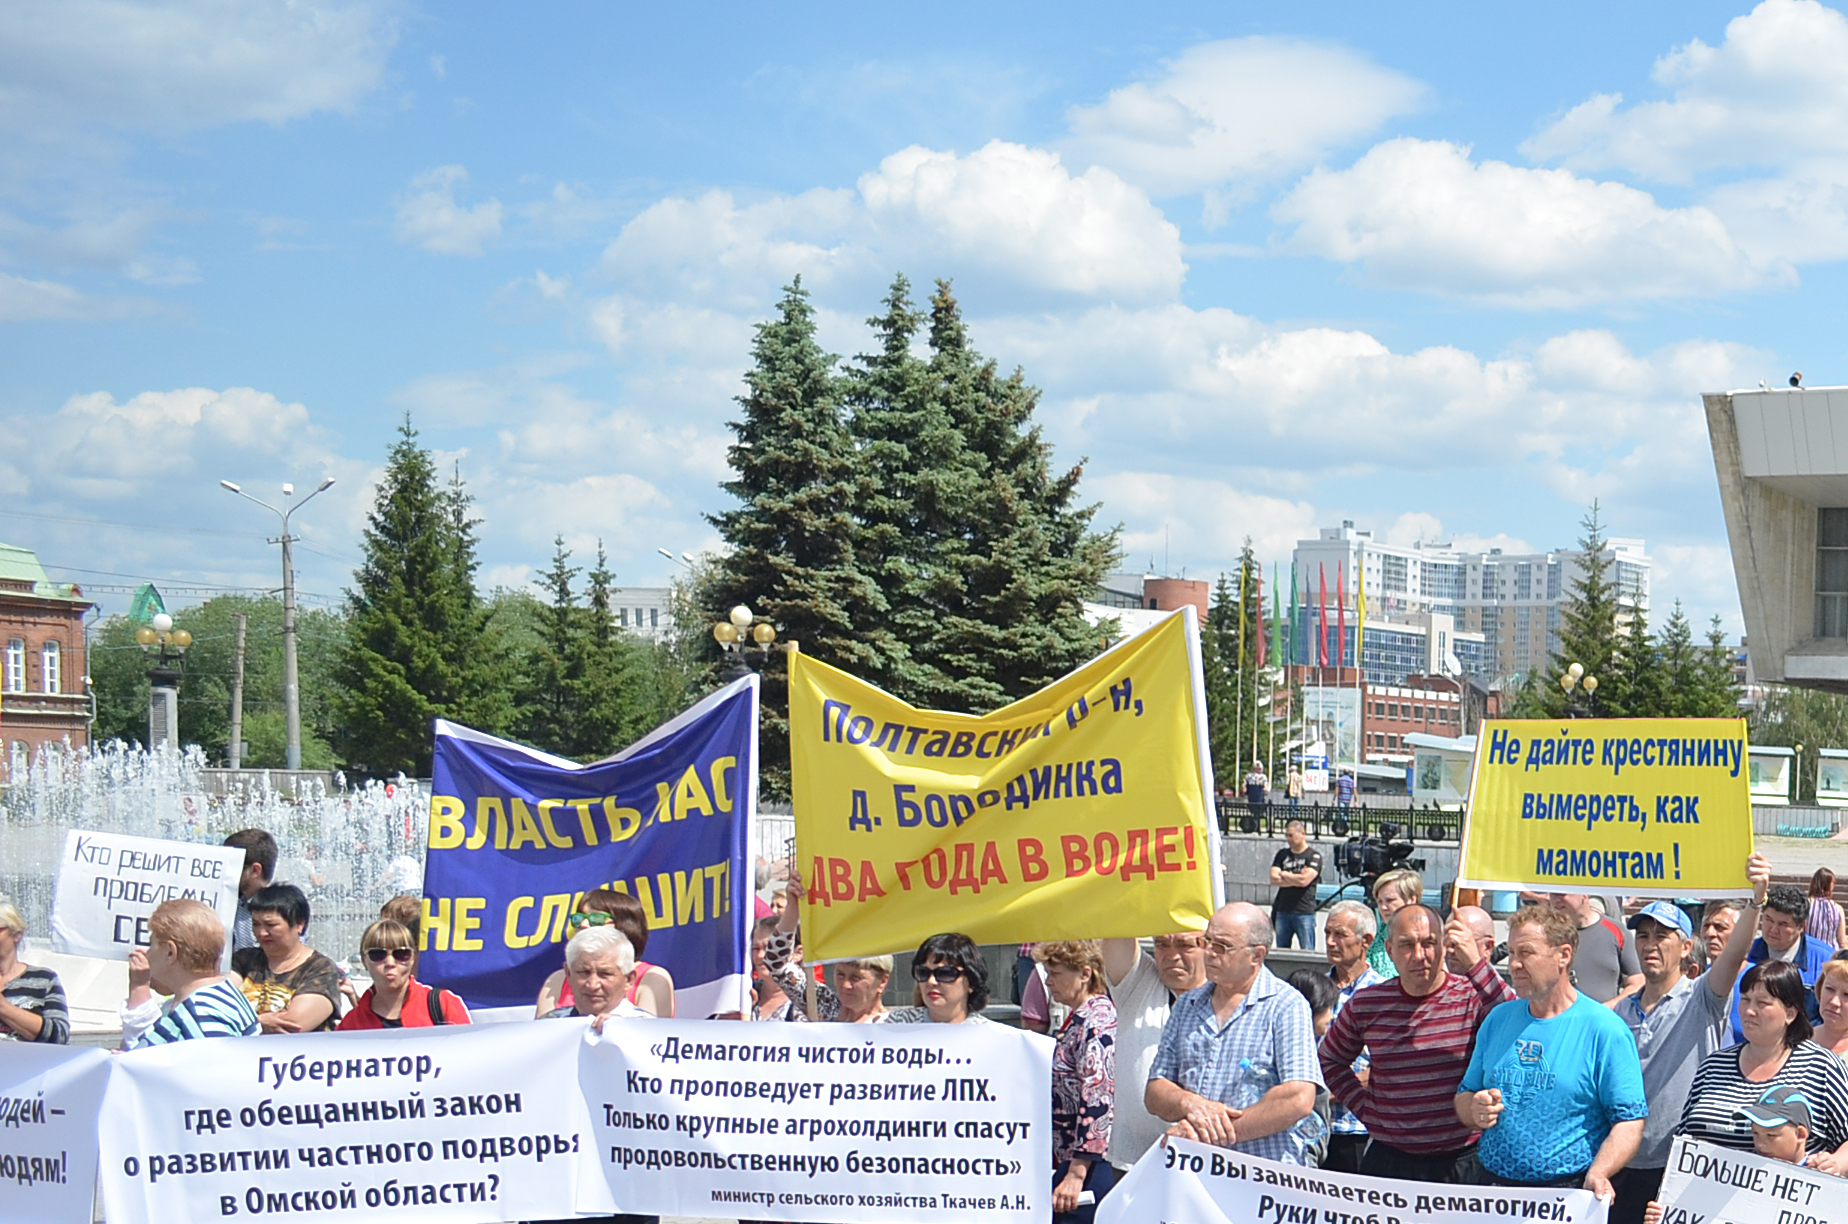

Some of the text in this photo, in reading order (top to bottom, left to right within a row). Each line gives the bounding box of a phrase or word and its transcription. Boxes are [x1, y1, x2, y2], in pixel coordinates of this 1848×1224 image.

[822, 676, 1145, 759] Полтавски р-н,
[1488, 728, 1743, 778] Не дайте крестянину
[848, 757, 1124, 833] д. Бородинка
[1521, 792, 1700, 832] вымереть, как
[428, 794, 642, 850] ВЛАСТЬ
[807, 825, 1197, 908] ДВА ГОДА В ВОДЕ!
[1535, 842, 1681, 880] мамонтам !
[419, 897, 486, 951] НЕ
[650, 1036, 791, 1064] «Демагогия
[798, 1041, 875, 1064] чистой
[258, 1054, 442, 1090] Губернатор,
[626, 1069, 997, 1106] Кто проповедует развитие ЛПХ.
[184, 1091, 522, 1135] где обещанный закон
[603, 1103, 1031, 1145] Только крупные агрохолдинги спасут
[124, 1155, 140, 1177] о
[149, 1149, 291, 1183] развитии
[298, 1140, 434, 1169] частного
[610, 1145, 1022, 1179] продовольственную безопасность»
[1677, 1140, 1821, 1205] БОЛЬШЕ НЕТ
[220, 1173, 500, 1216] в Омской области?
[711, 1190, 1031, 1210] министр сельского хозяйства Ткачев А.Н.
[1165, 1145, 1572, 1223] Это Вы занимаетесь демагогией.
